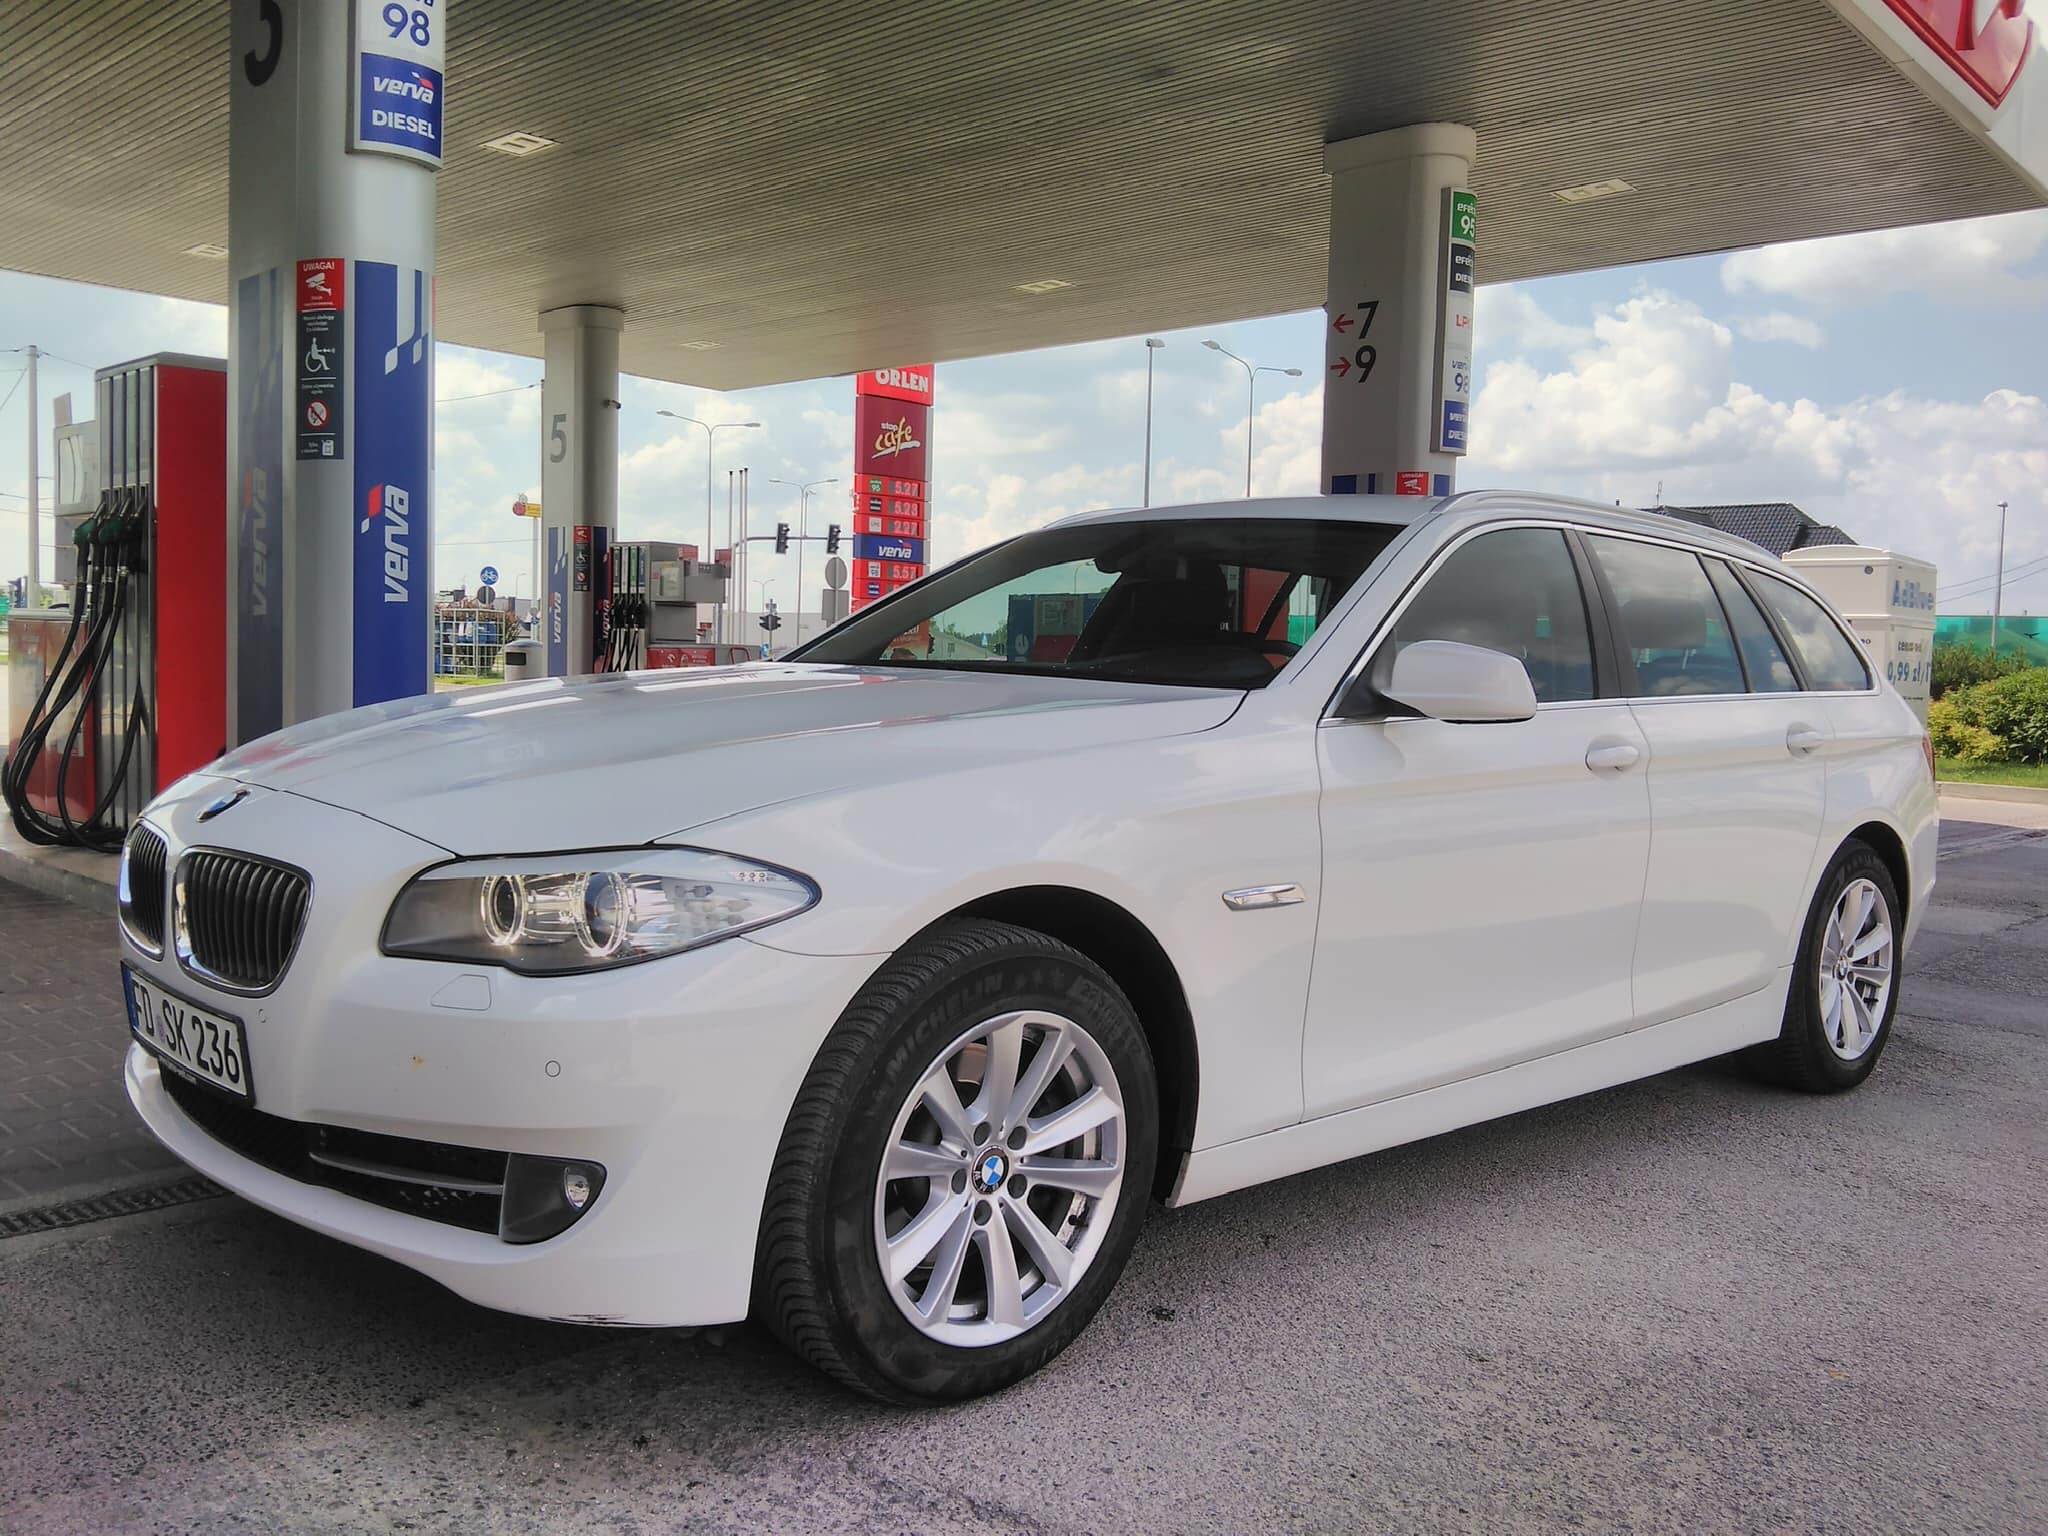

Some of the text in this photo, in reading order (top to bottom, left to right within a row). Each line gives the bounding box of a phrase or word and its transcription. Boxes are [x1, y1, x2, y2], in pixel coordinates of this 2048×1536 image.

[382, 3, 430, 47] 98
[373, 76, 434, 104] verva
[372, 109, 435, 139] DIESEL
[1357, 301, 1379, 339] 7
[875, 369, 928, 393] ORLEN
[1355, 345, 1376, 383] 9
[550, 413, 567, 464] 5
[384, 484, 409, 603] verva
[878, 546, 912, 558] verva
[162, 1000, 191, 1061] SK
[191, 1015, 240, 1083] 236
